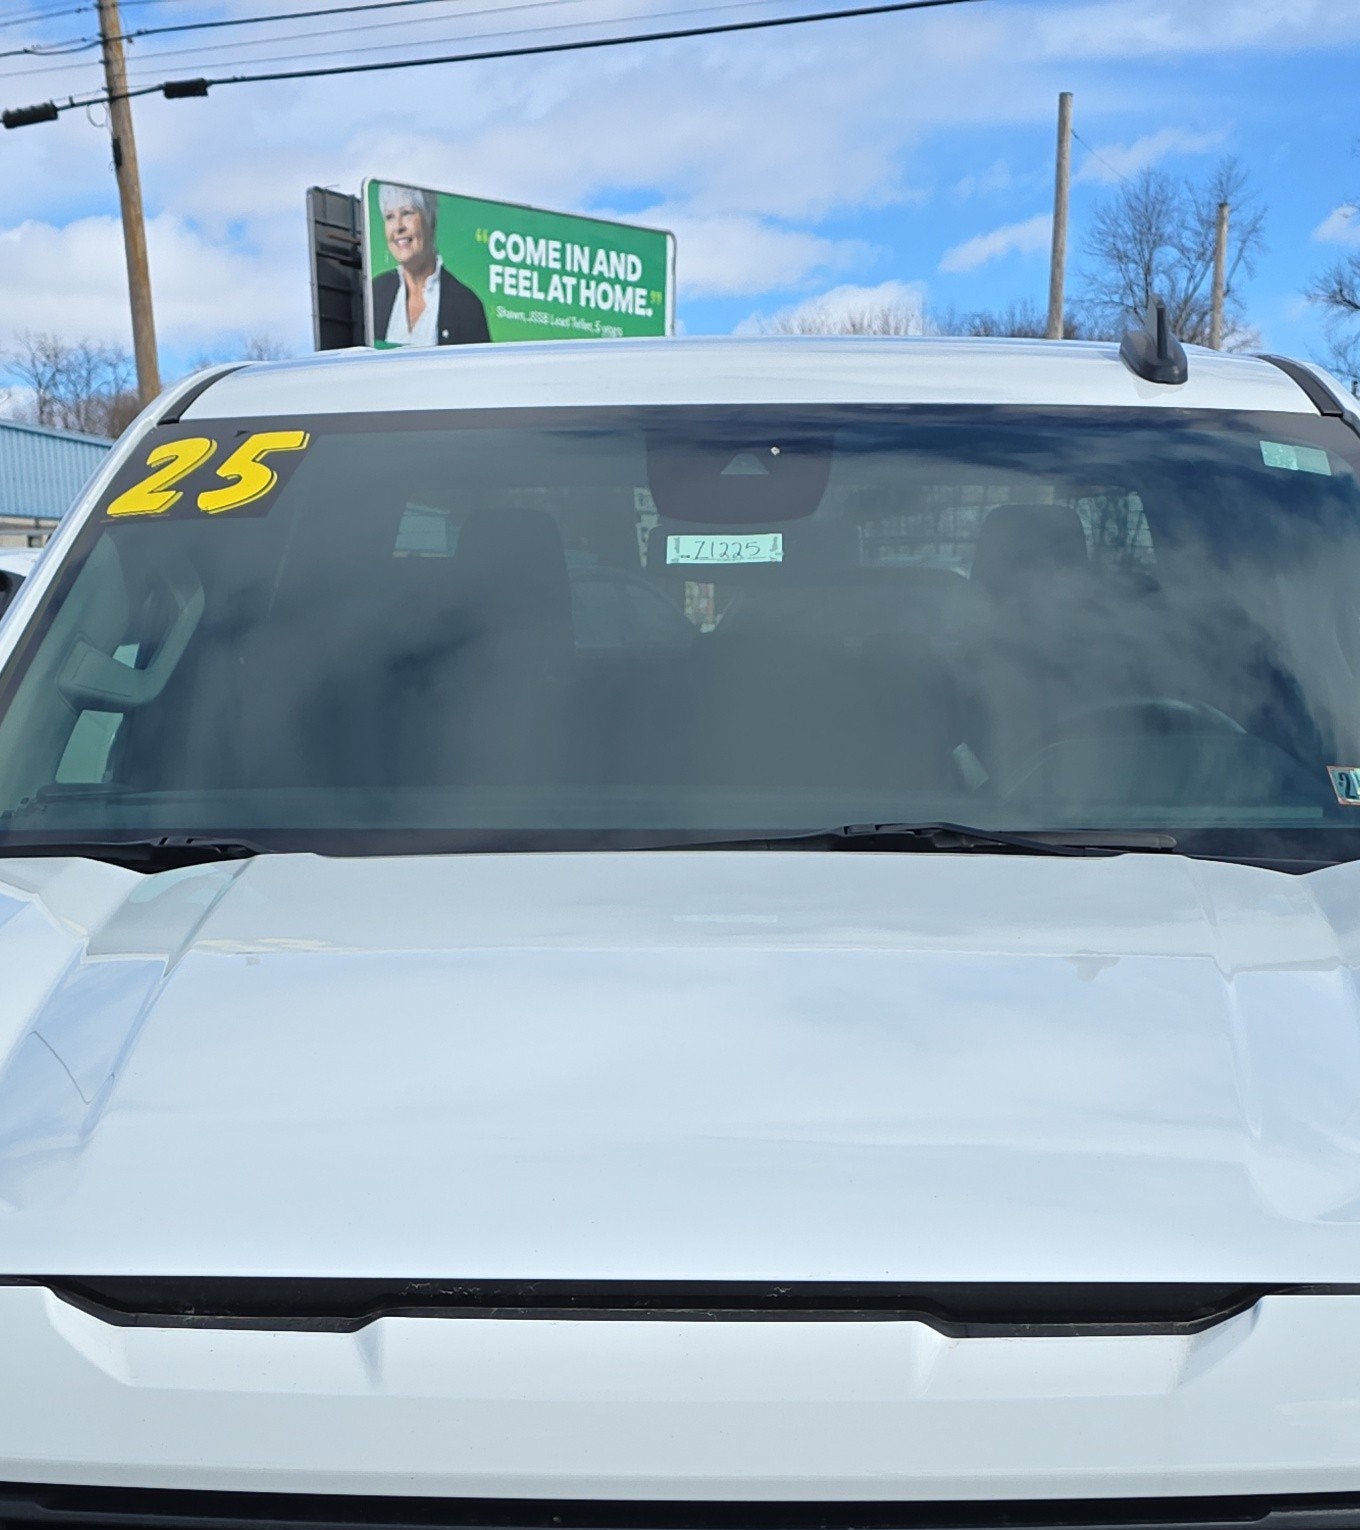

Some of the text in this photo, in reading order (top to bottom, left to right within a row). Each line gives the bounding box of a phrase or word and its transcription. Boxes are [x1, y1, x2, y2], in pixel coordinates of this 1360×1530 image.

[565, 242, 590, 275] IN
[592, 249, 643, 282] AND
[489, 264, 546, 300] FEEL
[547, 274, 577, 305] AT
[107, 431, 310, 515] 25
